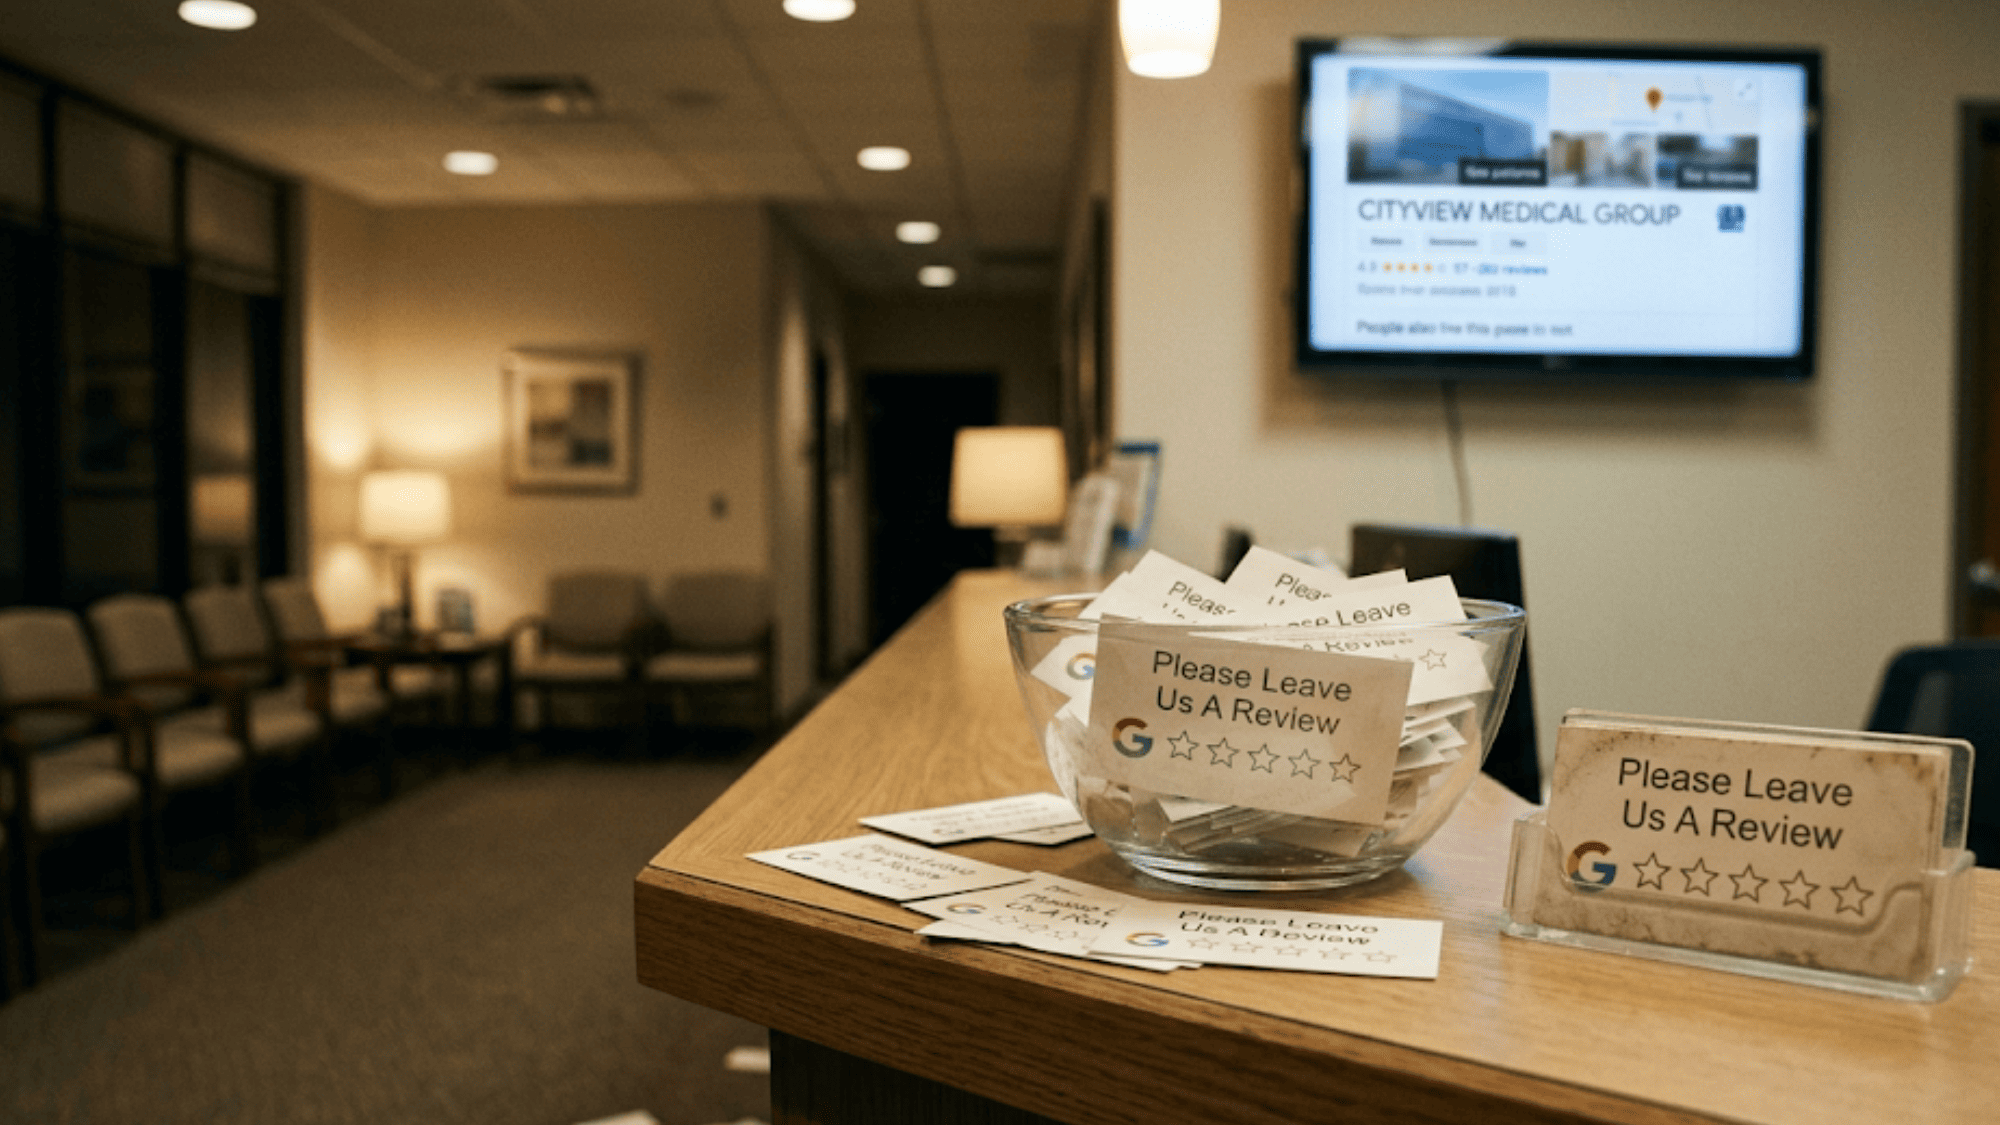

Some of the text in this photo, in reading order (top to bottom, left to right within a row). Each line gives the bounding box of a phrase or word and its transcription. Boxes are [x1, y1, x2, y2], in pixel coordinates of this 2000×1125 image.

[1358, 199, 1682, 226] CITYVIEW MEDICAL GROUP
[1167, 581, 1237, 616] Pleas
[1275, 573, 1333, 601] Plea
[1336, 602, 1411, 627] Leave
[1153, 650, 1352, 702] Please Leave
[1156, 685, 1341, 735] Us A Review
[1618, 757, 1853, 806] Please Leave
[1622, 800, 1844, 850] Us A Review
